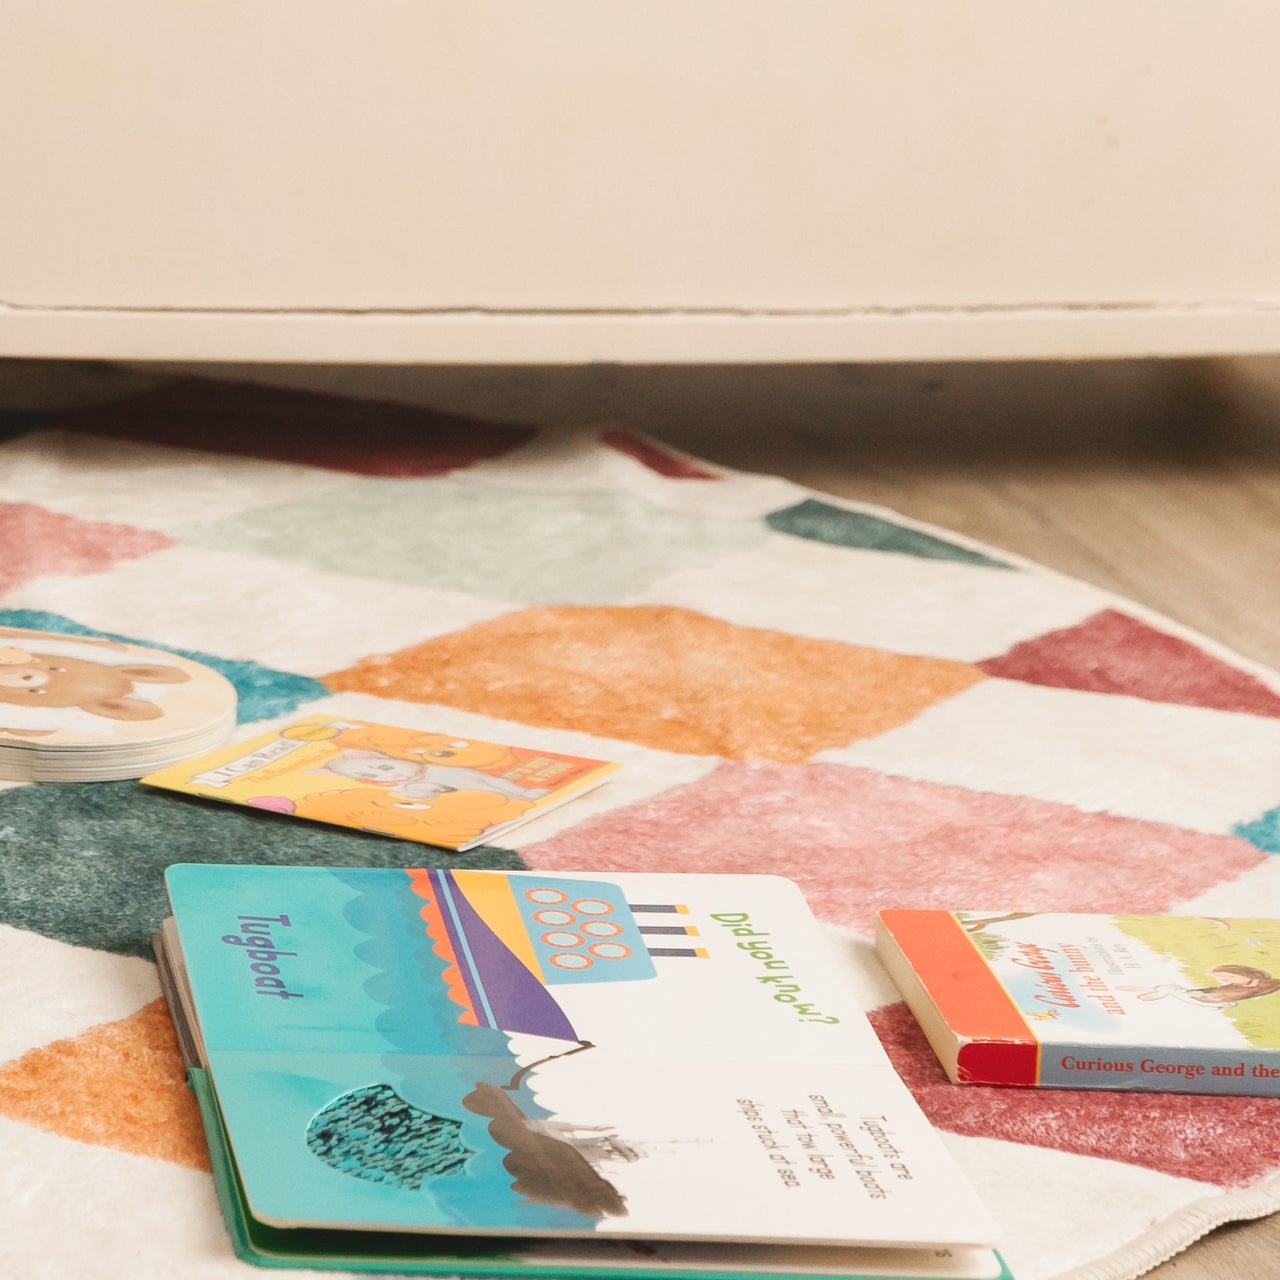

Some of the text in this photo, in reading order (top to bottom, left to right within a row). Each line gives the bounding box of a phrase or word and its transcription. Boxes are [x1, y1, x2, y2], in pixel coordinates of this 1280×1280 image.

[221, 914, 304, 1000] Tugboat
[709, 912, 840, 1025] Did you know?
[1033, 970, 1080, 1008] Curious
[1057, 943, 1126, 1015] and the bunny
[1060, 1055, 1280, 1080] Curious George and the
[735, 1098, 766, 1122] ships
[751, 1123, 791, 1151] stuck
[768, 1153, 798, 1166] at
[780, 1109, 836, 1181] that tow large
[819, 1122, 879, 1167] powerful
[855, 1169, 893, 1200] boats
[859, 1115, 913, 1181] Tugboats are
